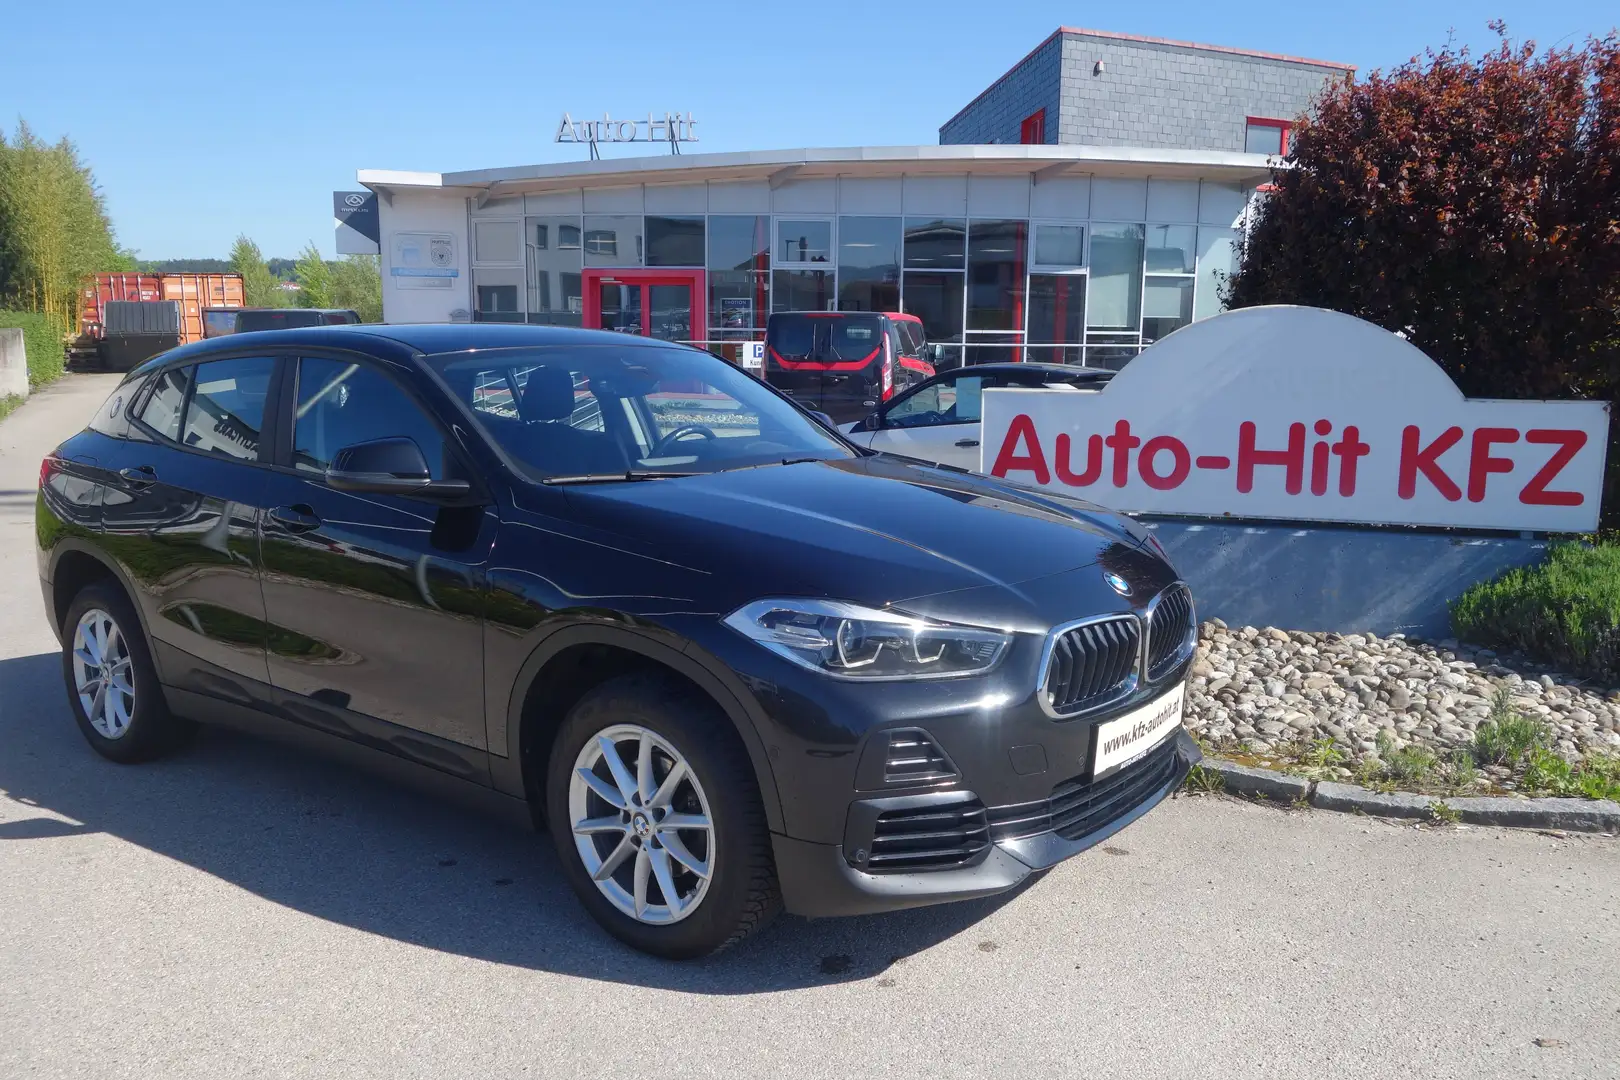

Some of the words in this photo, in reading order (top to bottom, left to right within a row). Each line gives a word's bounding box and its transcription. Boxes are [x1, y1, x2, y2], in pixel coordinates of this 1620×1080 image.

[555, 112, 637, 142] Auto
[648, 112, 699, 142] Hit
[991, 414, 1370, 496] Auto-Hit
[1398, 424, 1588, 506] KFZ
[1103, 696, 1180, 755] www.kfz-autohit.at
